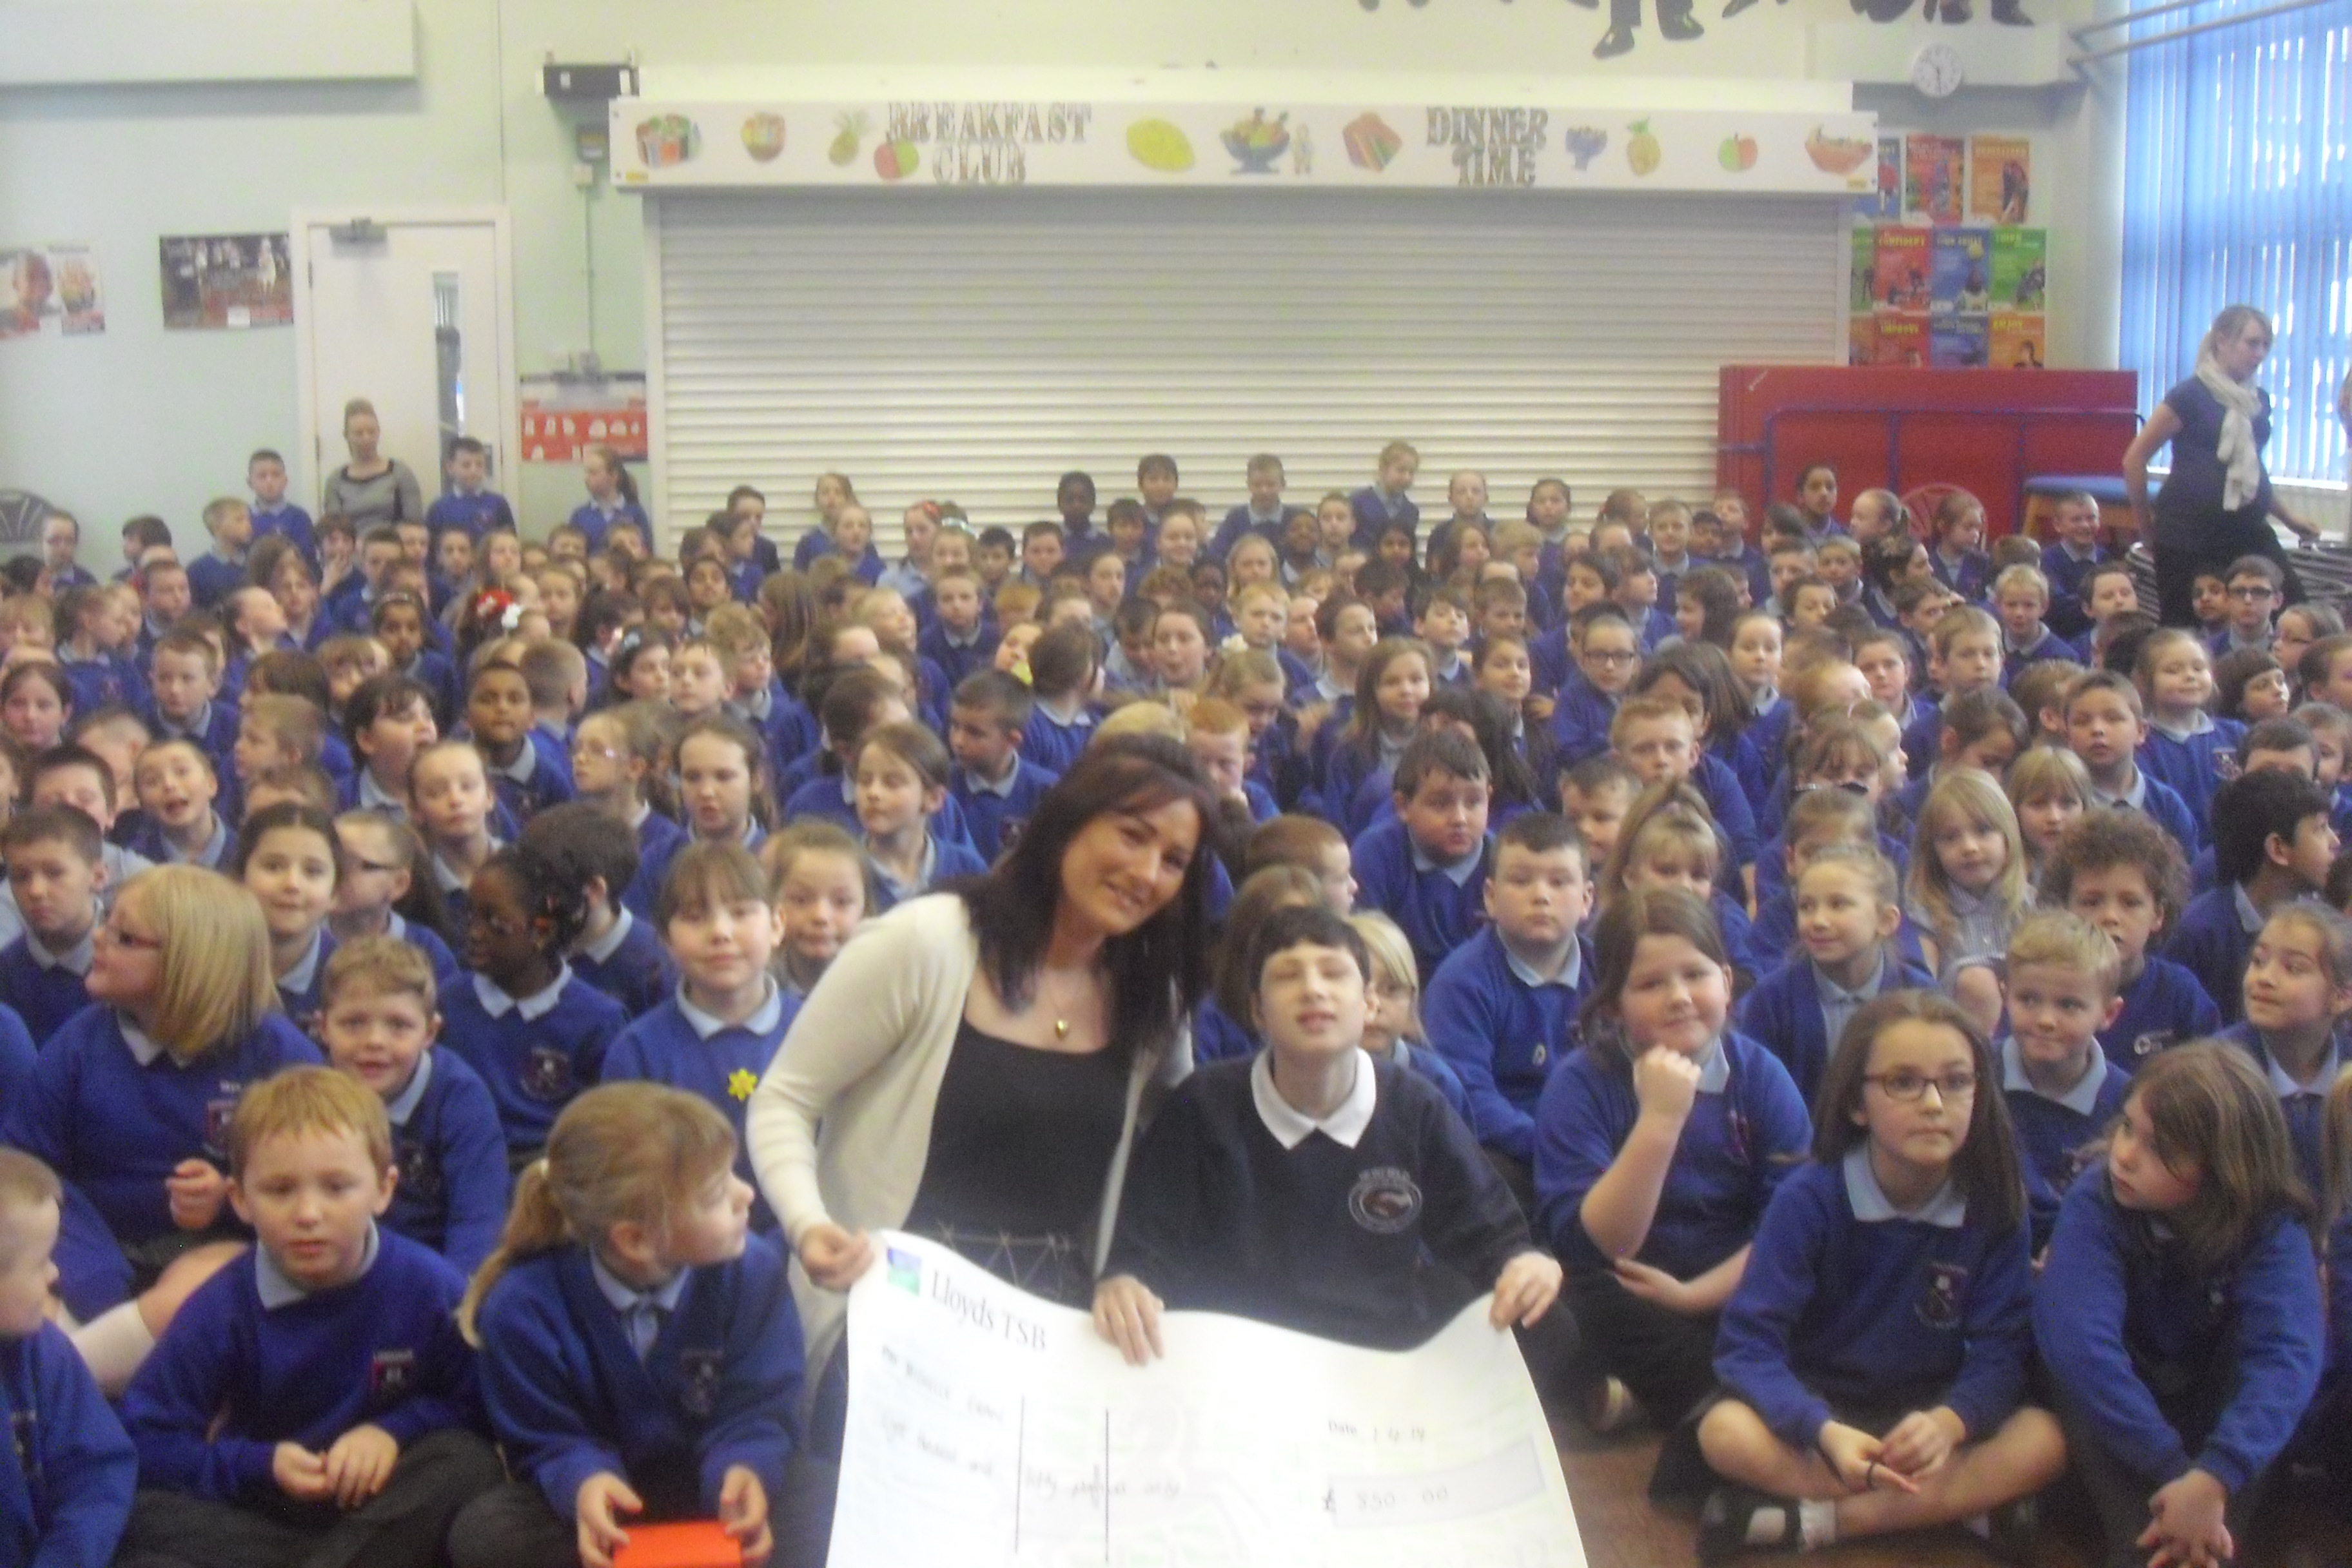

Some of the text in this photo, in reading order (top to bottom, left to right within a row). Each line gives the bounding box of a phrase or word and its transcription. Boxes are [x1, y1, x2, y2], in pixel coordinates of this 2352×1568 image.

[887, 101, 1092, 144] BREAKFAST
[1426, 104, 1549, 149] DINNER
[932, 141, 1026, 184] CLUB
[1452, 142, 1536, 187] TIME
[932, 1269, 1047, 1350] Lloyds TSB
